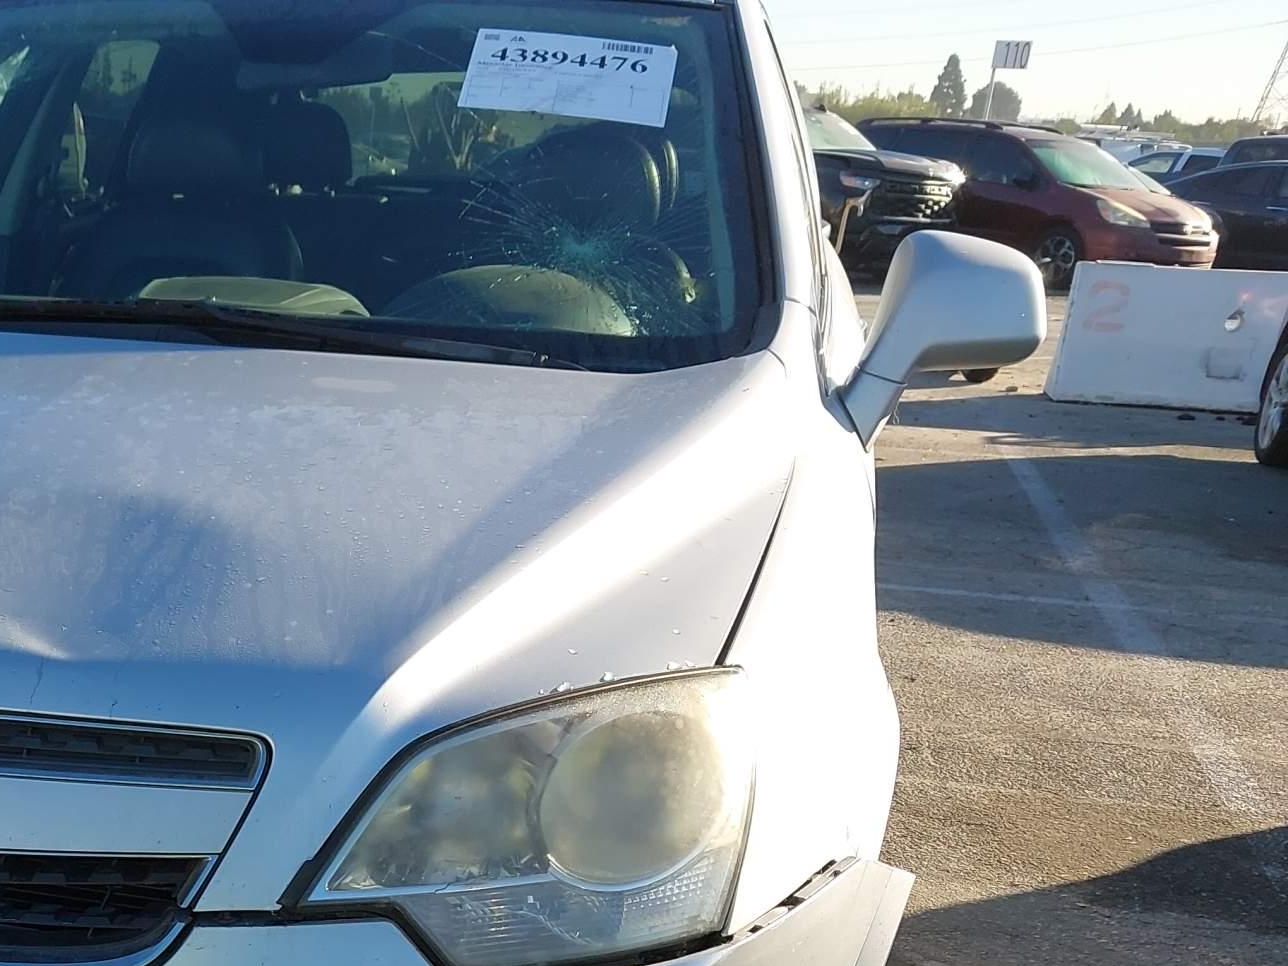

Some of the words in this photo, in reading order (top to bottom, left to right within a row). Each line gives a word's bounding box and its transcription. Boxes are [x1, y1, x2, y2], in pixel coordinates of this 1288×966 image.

[491, 47, 648, 74] 43894476
[1003, 41, 1031, 69] 110
[1082, 279, 1130, 332] 2
